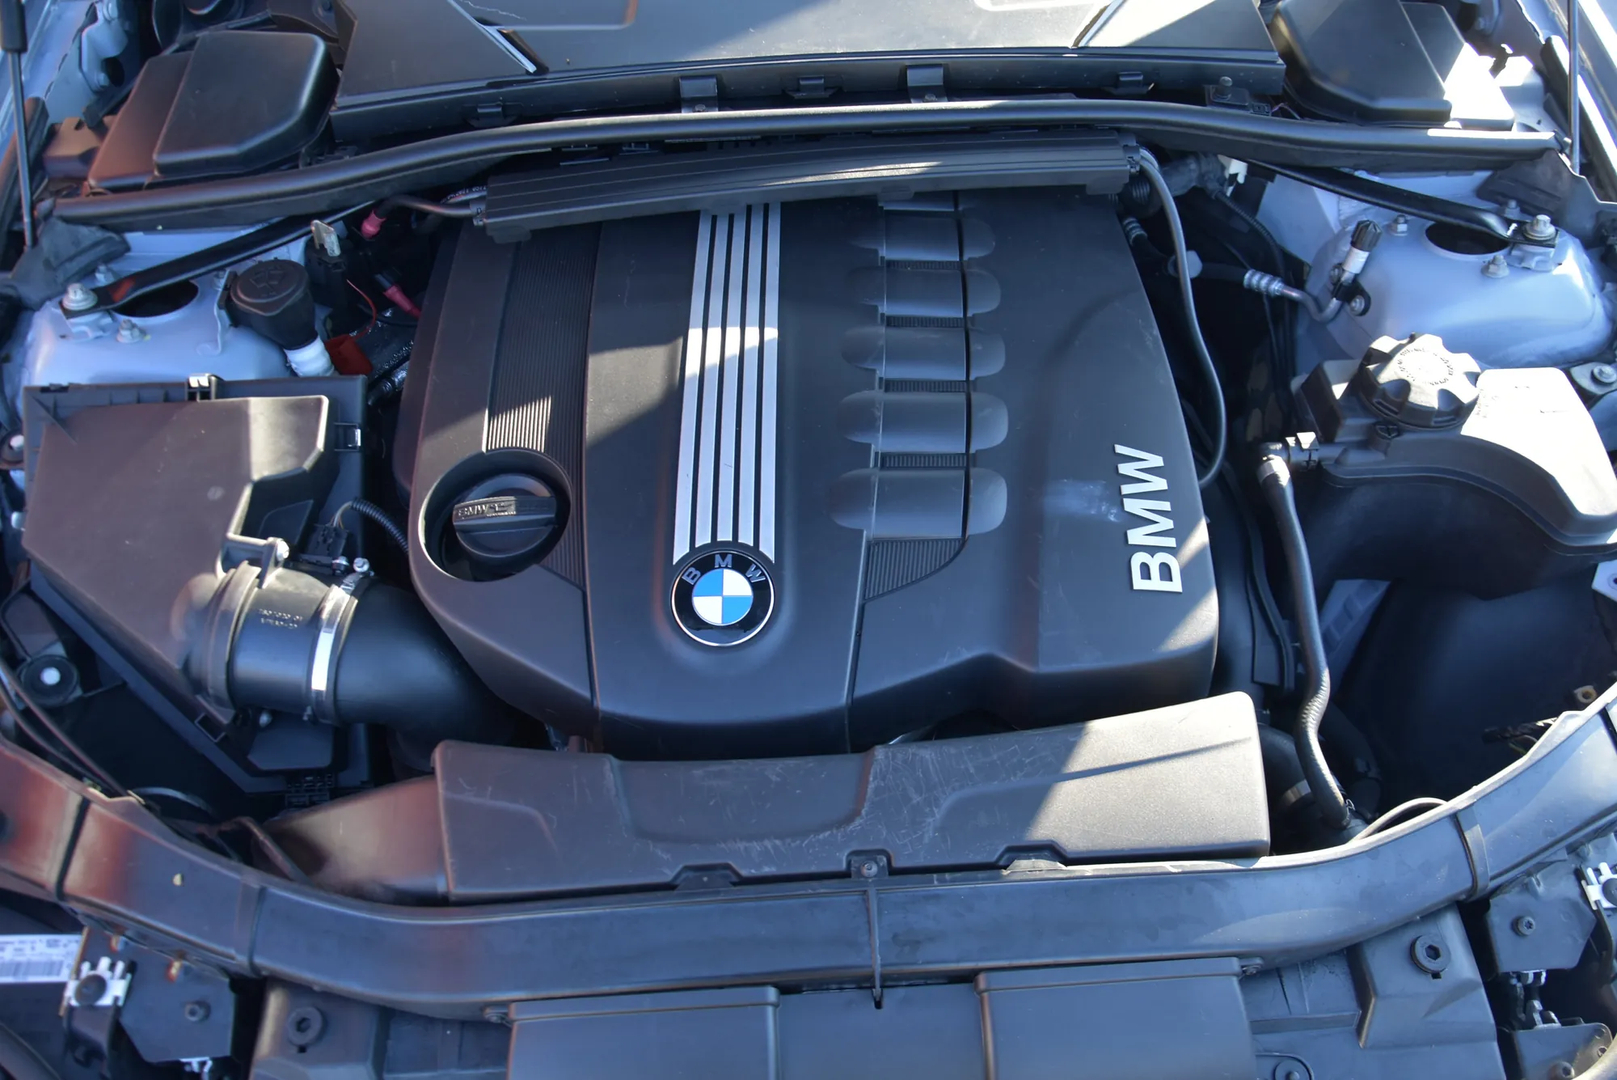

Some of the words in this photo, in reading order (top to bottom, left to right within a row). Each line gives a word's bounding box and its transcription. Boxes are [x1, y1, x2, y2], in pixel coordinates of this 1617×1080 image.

[458, 504, 489, 516] BMW
[1114, 444, 1182, 593] BMW
[681, 553, 766, 586] BMW
